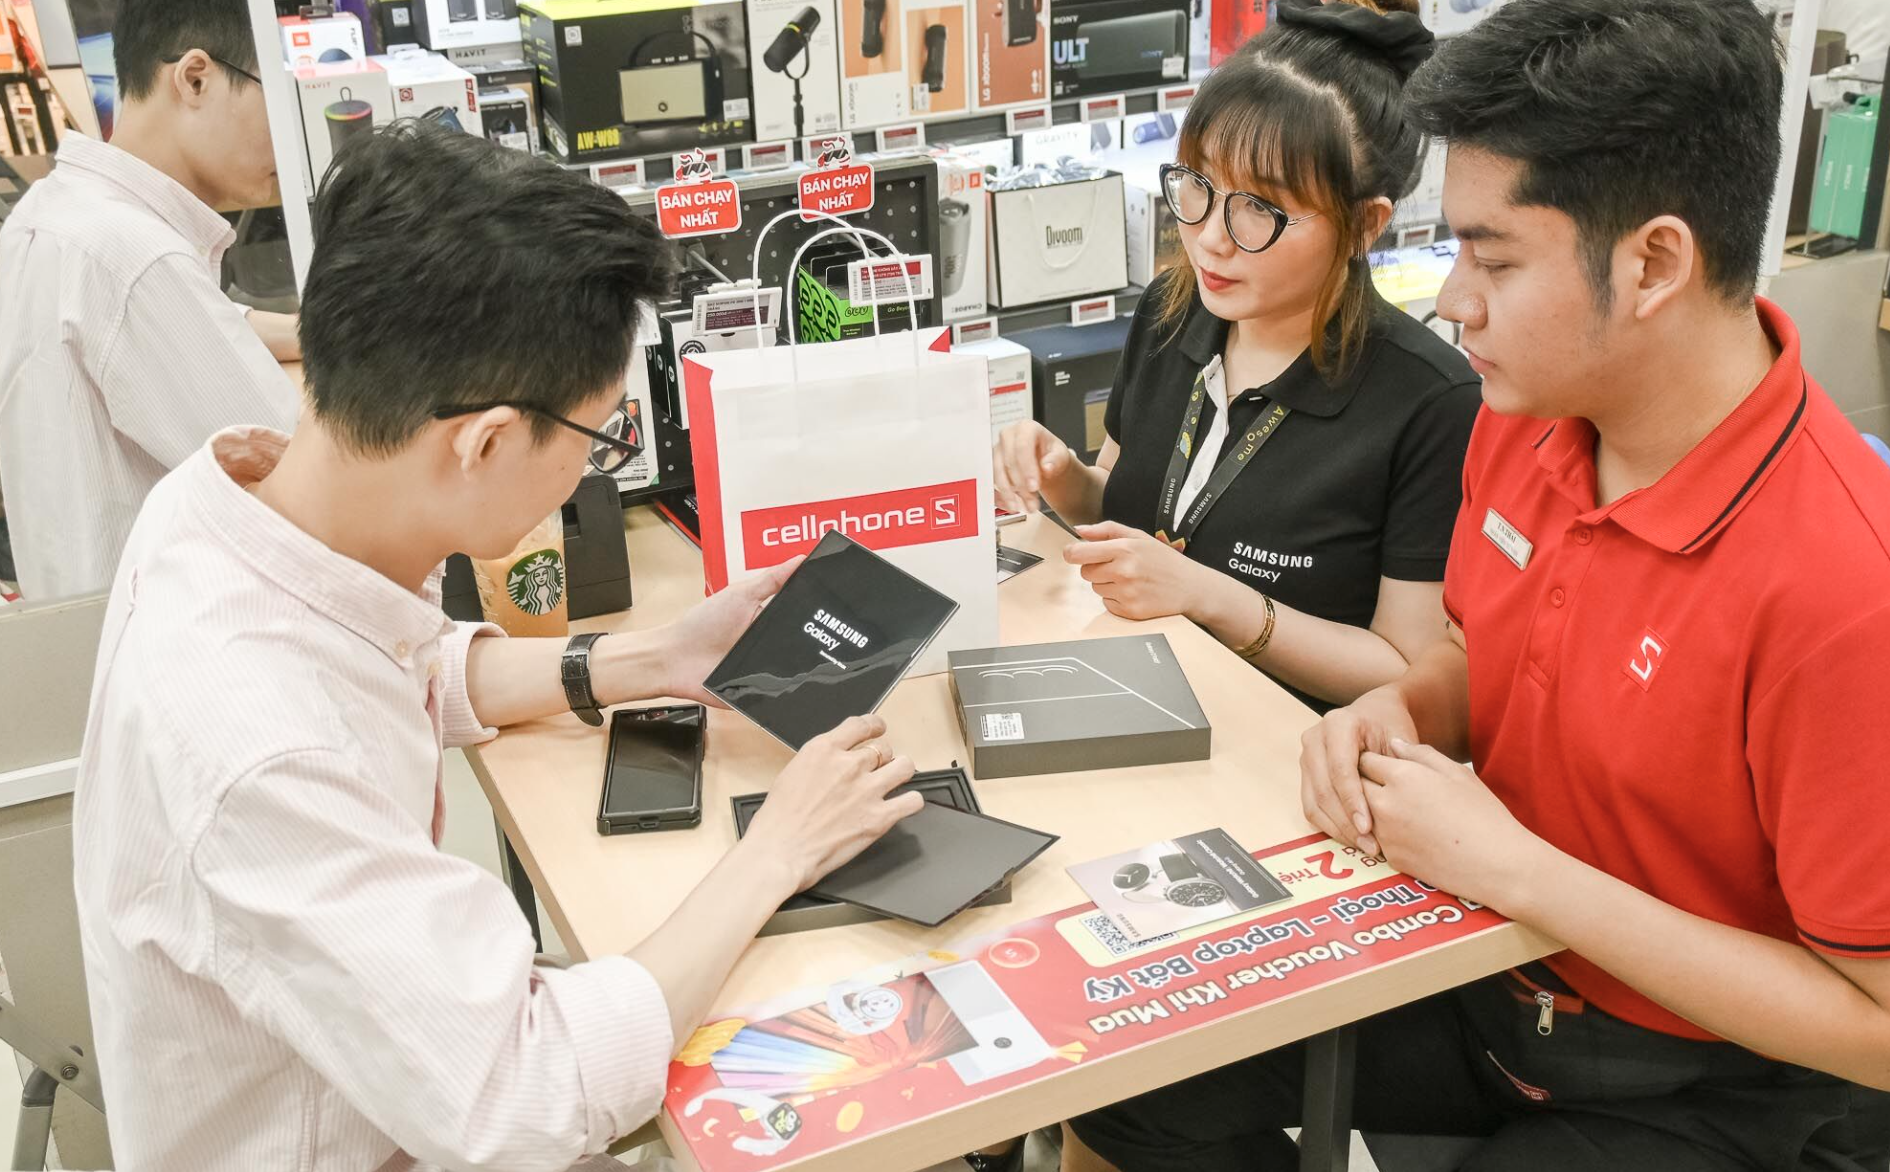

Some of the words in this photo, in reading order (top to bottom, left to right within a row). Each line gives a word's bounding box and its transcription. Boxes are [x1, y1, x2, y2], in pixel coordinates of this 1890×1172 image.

[1053, 15, 1078, 24] SONY
[455, 49, 487, 58] HAVIT
[1053, 37, 1089, 64] ULT
[304, 81, 331, 90] HAVIT
[802, 179, 831, 195] BÁN
[832, 173, 869, 189] CHẠY
[660, 193, 692, 209] BÁN
[694, 188, 733, 206] CHẠY
[818, 193, 854, 211] NHẤT
[680, 211, 719, 228] NHẤT
[1046, 225, 1083, 246] Divoom
[1163, 477, 1177, 515] SAMSUNG
[1188, 492, 1212, 525] SAMSUNG
[1233, 541, 1313, 568] SAMSUNG
[1228, 558, 1281, 583] Galaxy
[803, 621, 841, 652] Galaxy
[813, 608, 869, 649] SAMSUNG
[1278, 868, 1319, 884] Triệ
[1303, 850, 1354, 879] 2
[1331, 881, 1428, 921] Thoại
[1353, 902, 1465, 948] Combo
[1193, 916, 1312, 964] Laptop
[1129, 953, 1199, 991] Bất
[1226, 938, 1359, 989] Voucher
[1083, 976, 1135, 1002] Kỳ
[1175, 982, 1229, 1014] Khi
[1088, 1000, 1171, 1036] Mua
